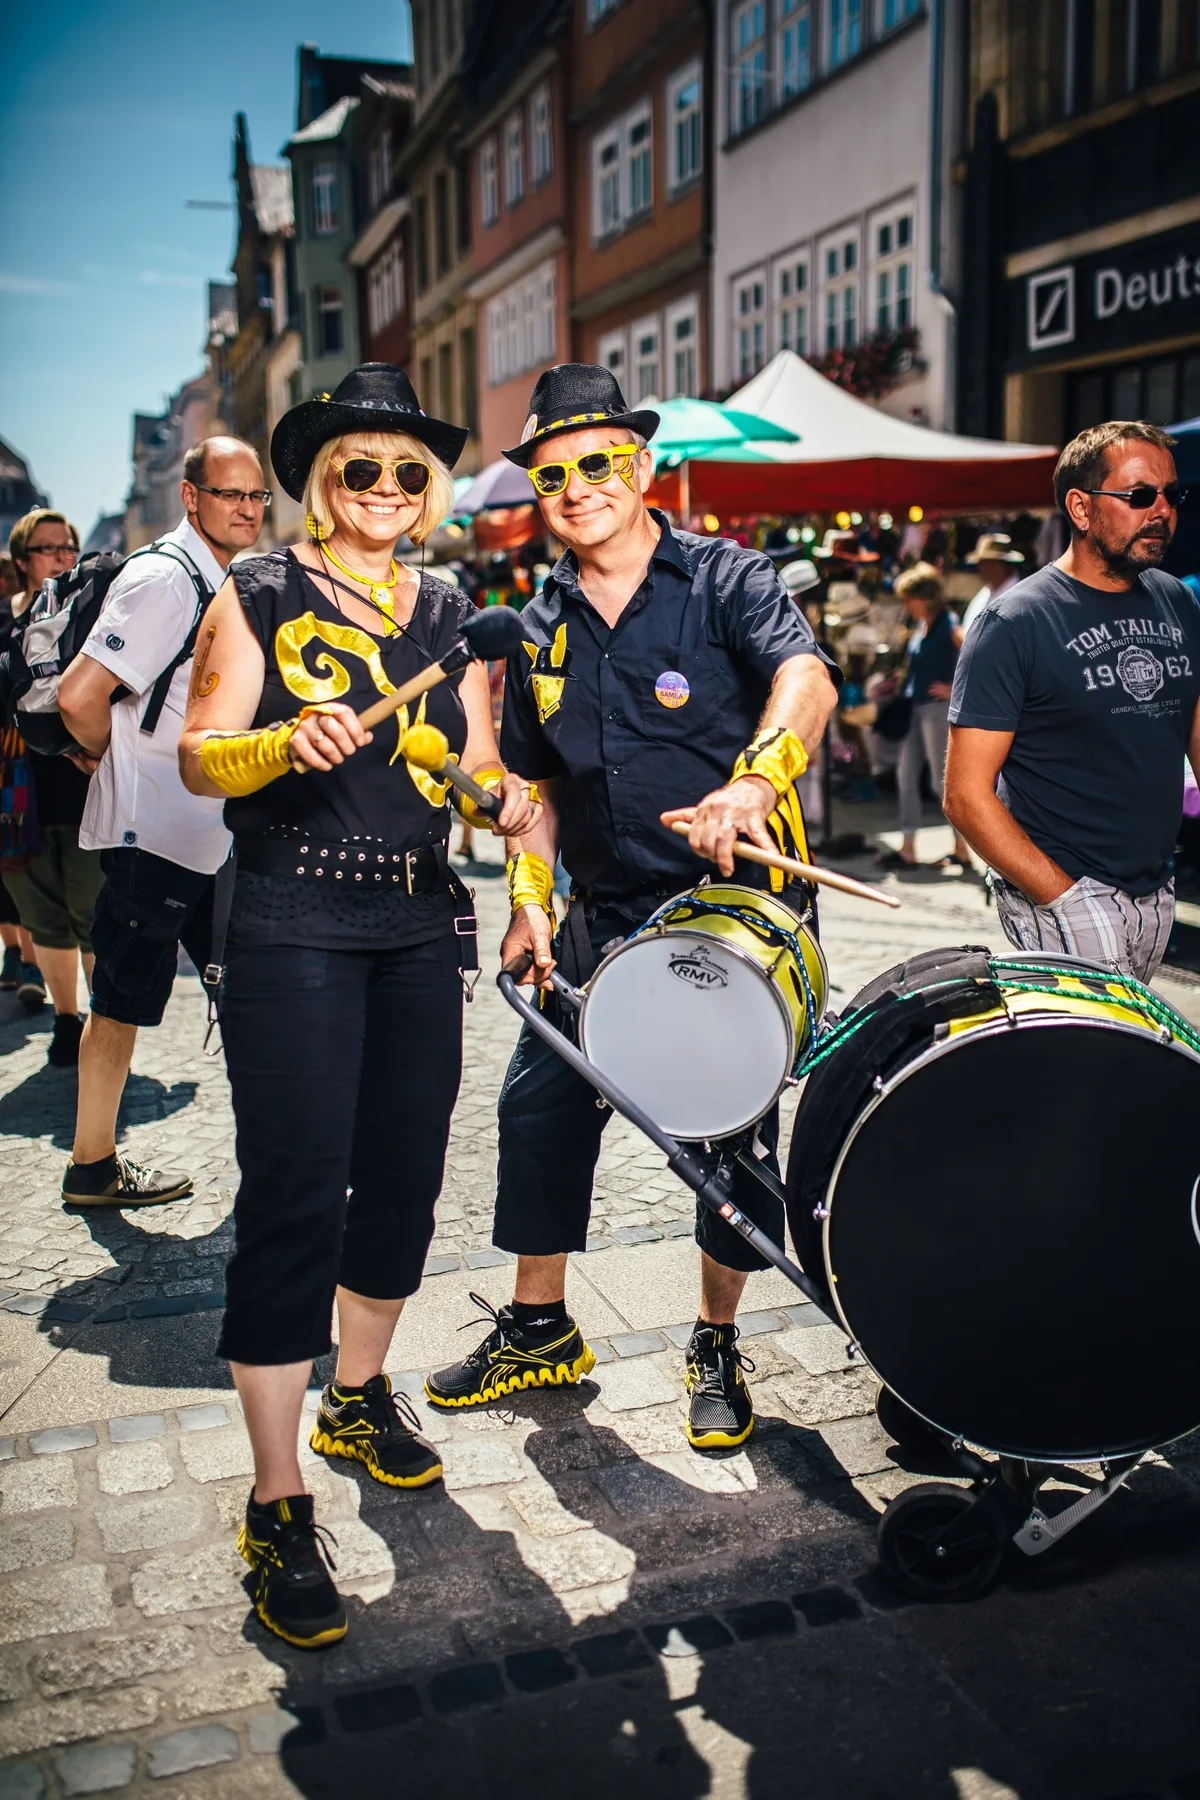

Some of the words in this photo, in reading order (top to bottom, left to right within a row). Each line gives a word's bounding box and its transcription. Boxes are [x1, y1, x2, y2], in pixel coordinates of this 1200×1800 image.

[1066, 623, 1113, 656] TOM
[1114, 619, 1183, 645] TAILOR
[1087, 643, 1111, 660] TRUSTED
[1110, 637, 1134, 648] QUALITY
[1083, 664, 1115, 691] 19
[1165, 655, 1193, 677] 62
[660, 690, 684, 699] SAMBA
[677, 965, 718, 984] RMV
